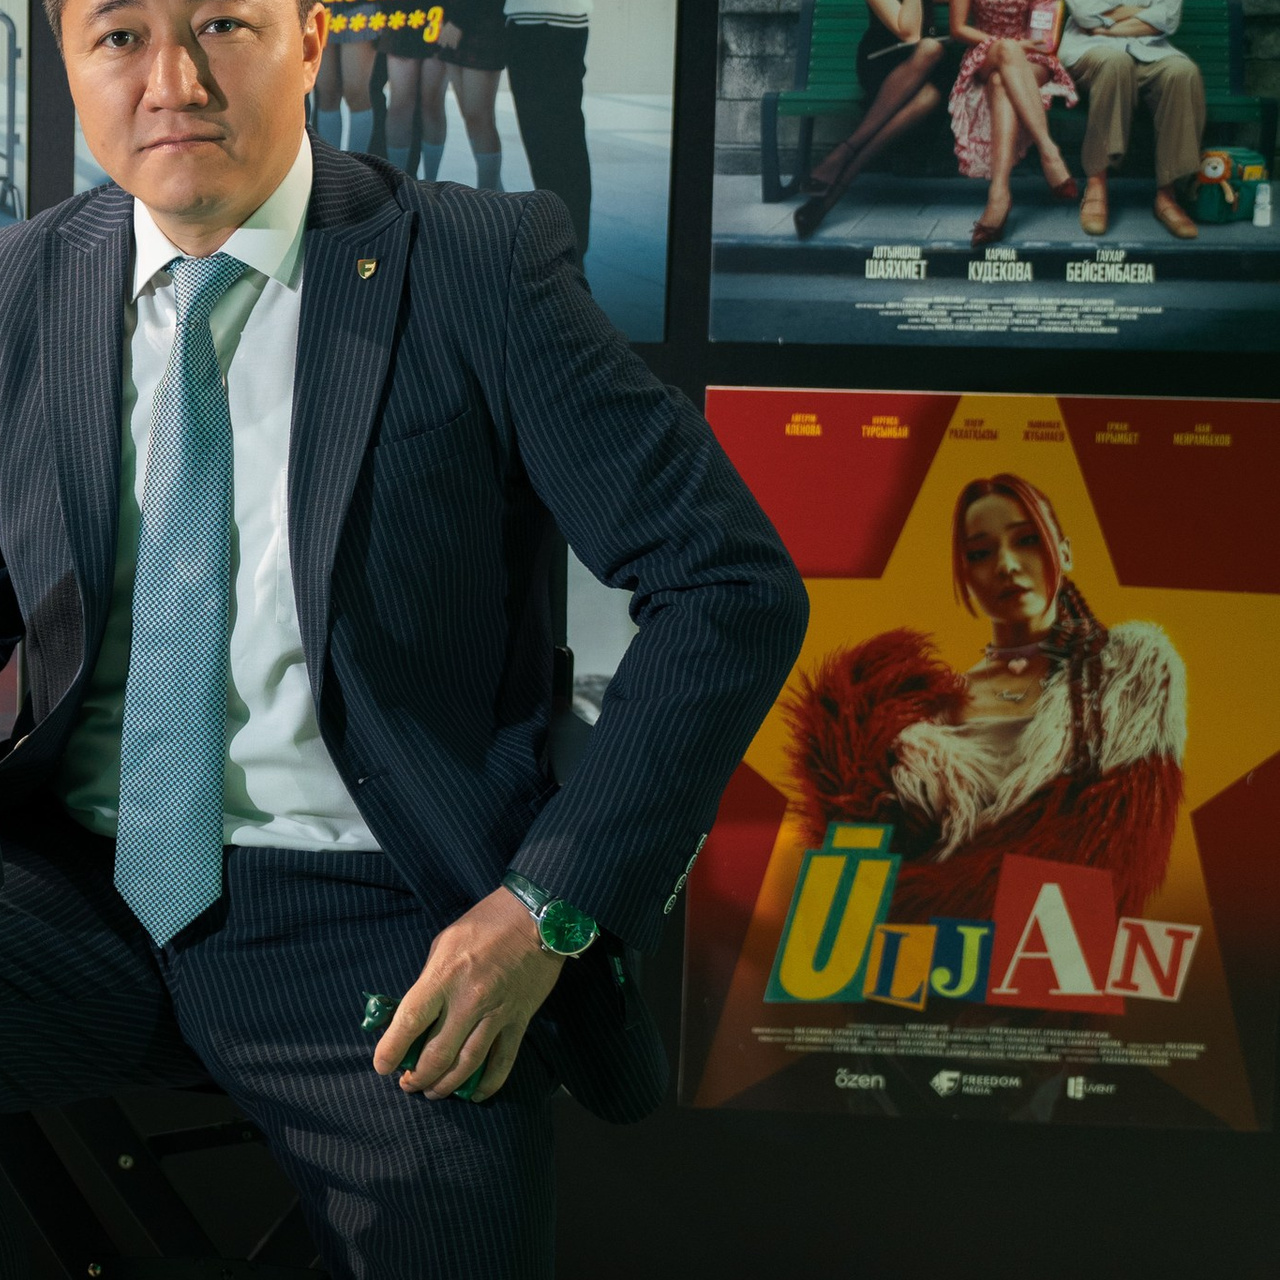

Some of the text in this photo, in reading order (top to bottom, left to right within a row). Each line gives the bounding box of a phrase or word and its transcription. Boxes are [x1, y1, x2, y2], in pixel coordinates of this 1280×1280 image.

[872, 245, 922, 260] АЛТЫНШАШ
[985, 248, 1016, 262] КАРИНА
[1096, 249, 1126, 263] ГАУХАР
[865, 259, 928, 280] ШАЯХМЕТ
[968, 260, 1033, 282] КУДЕКОВА
[1066, 259, 1155, 283] БЕЙСЕМБАЕВА
[962, 1075, 1020, 1087] FREEDOM
